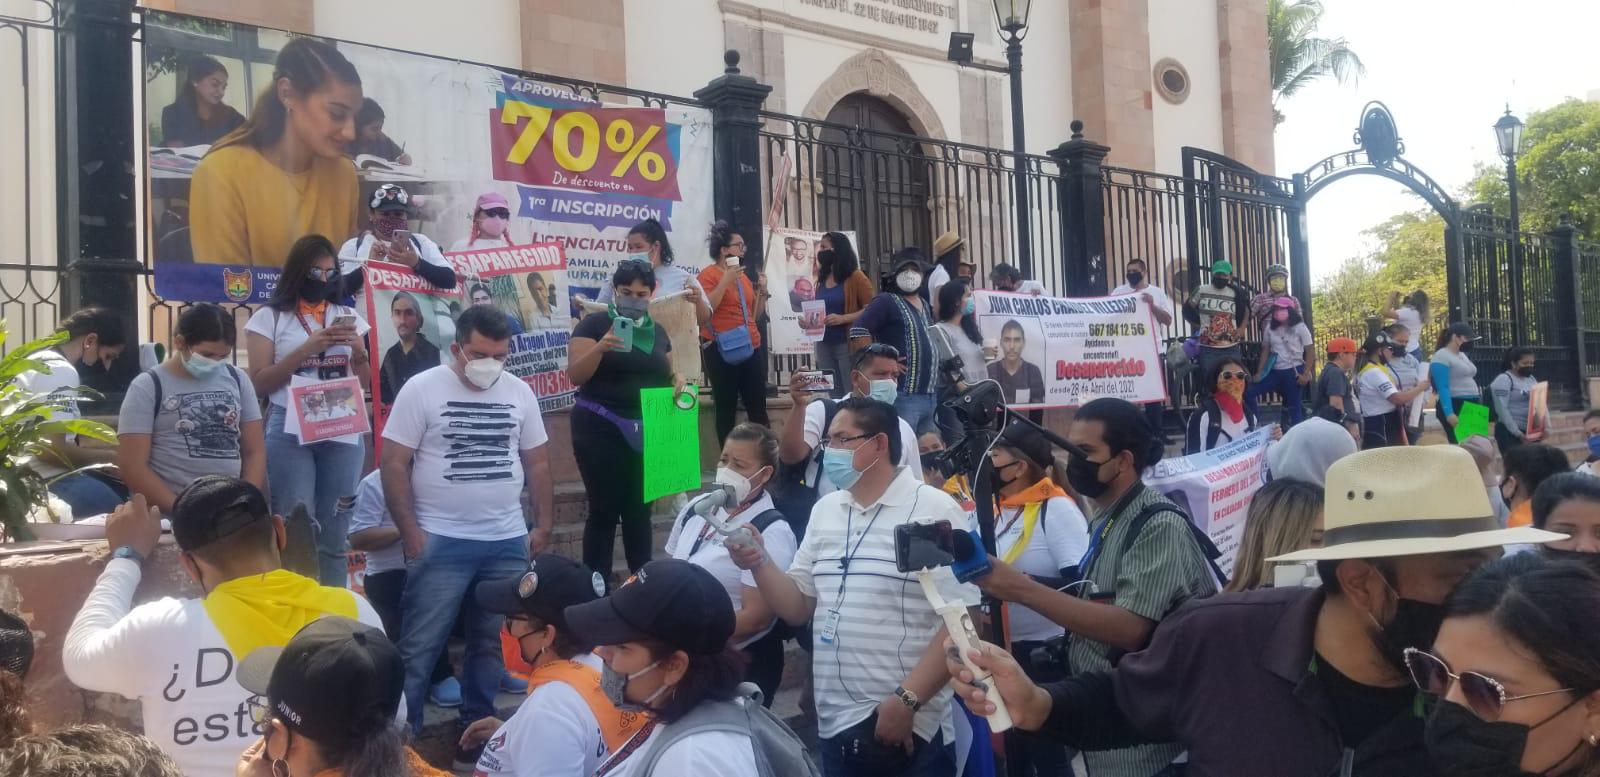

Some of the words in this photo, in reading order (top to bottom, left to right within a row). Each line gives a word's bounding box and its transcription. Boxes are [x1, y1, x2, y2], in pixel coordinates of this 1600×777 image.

[501, 99, 666, 182] 70%
[552, 171, 568, 185] De
[570, 174, 620, 191] descuento
[623, 182, 635, 191] en
[528, 196, 546, 210] 1ra
[551, 198, 661, 220] INSCRIPCIÓN
[532, 232, 632, 254] LICENCIATU
[450, 244, 561, 276] ESAPARECIDO
[988, 295, 1011, 313] JUAN
[1012, 297, 1051, 315] CARLOS
[1089, 323, 1105, 337] 667
[1106, 323, 1119, 337] 184
[1120, 323, 1129, 336] 12
[1131, 322, 1145, 336] 56
[1055, 358, 1145, 380] Desaparecido
[1049, 386, 1070, 394] desde
[1071, 382, 1079, 396] 28
[1091, 381, 1106, 394] Abril
[1106, 382, 1118, 394] del
[1119, 380, 1135, 393] 2021
[277, 701, 302, 727] JUNIOR
